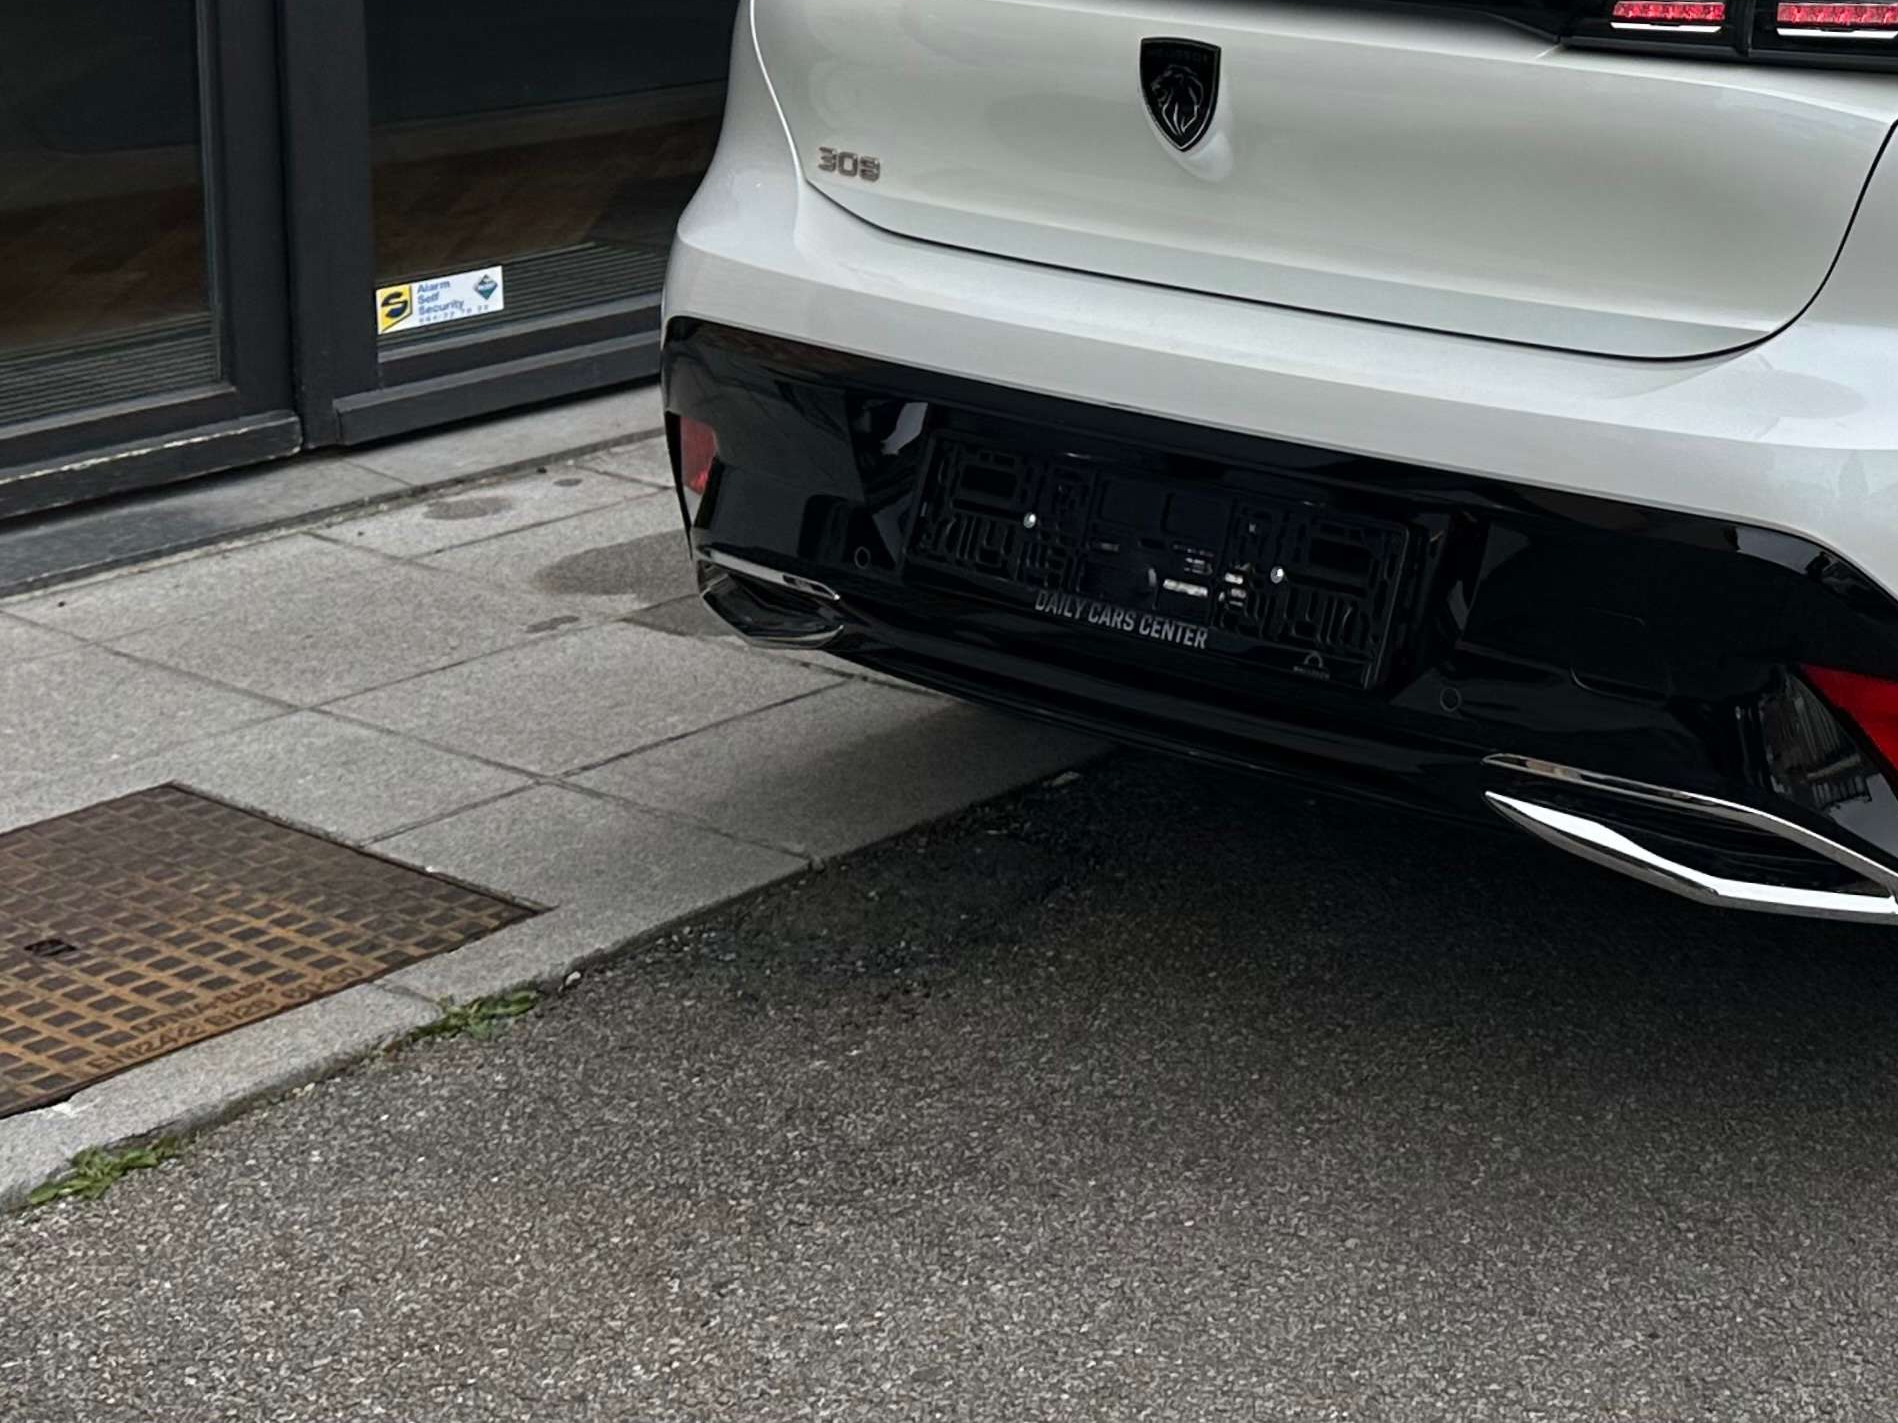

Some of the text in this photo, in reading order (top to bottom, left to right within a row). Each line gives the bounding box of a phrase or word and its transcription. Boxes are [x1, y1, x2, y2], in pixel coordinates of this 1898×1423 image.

[818, 146, 880, 183] 308
[417, 280, 450, 294] Alarm
[417, 291, 440, 305] Self
[418, 299, 465, 315] Security
[1035, 590, 1208, 649] DAILY CARS CENTER
